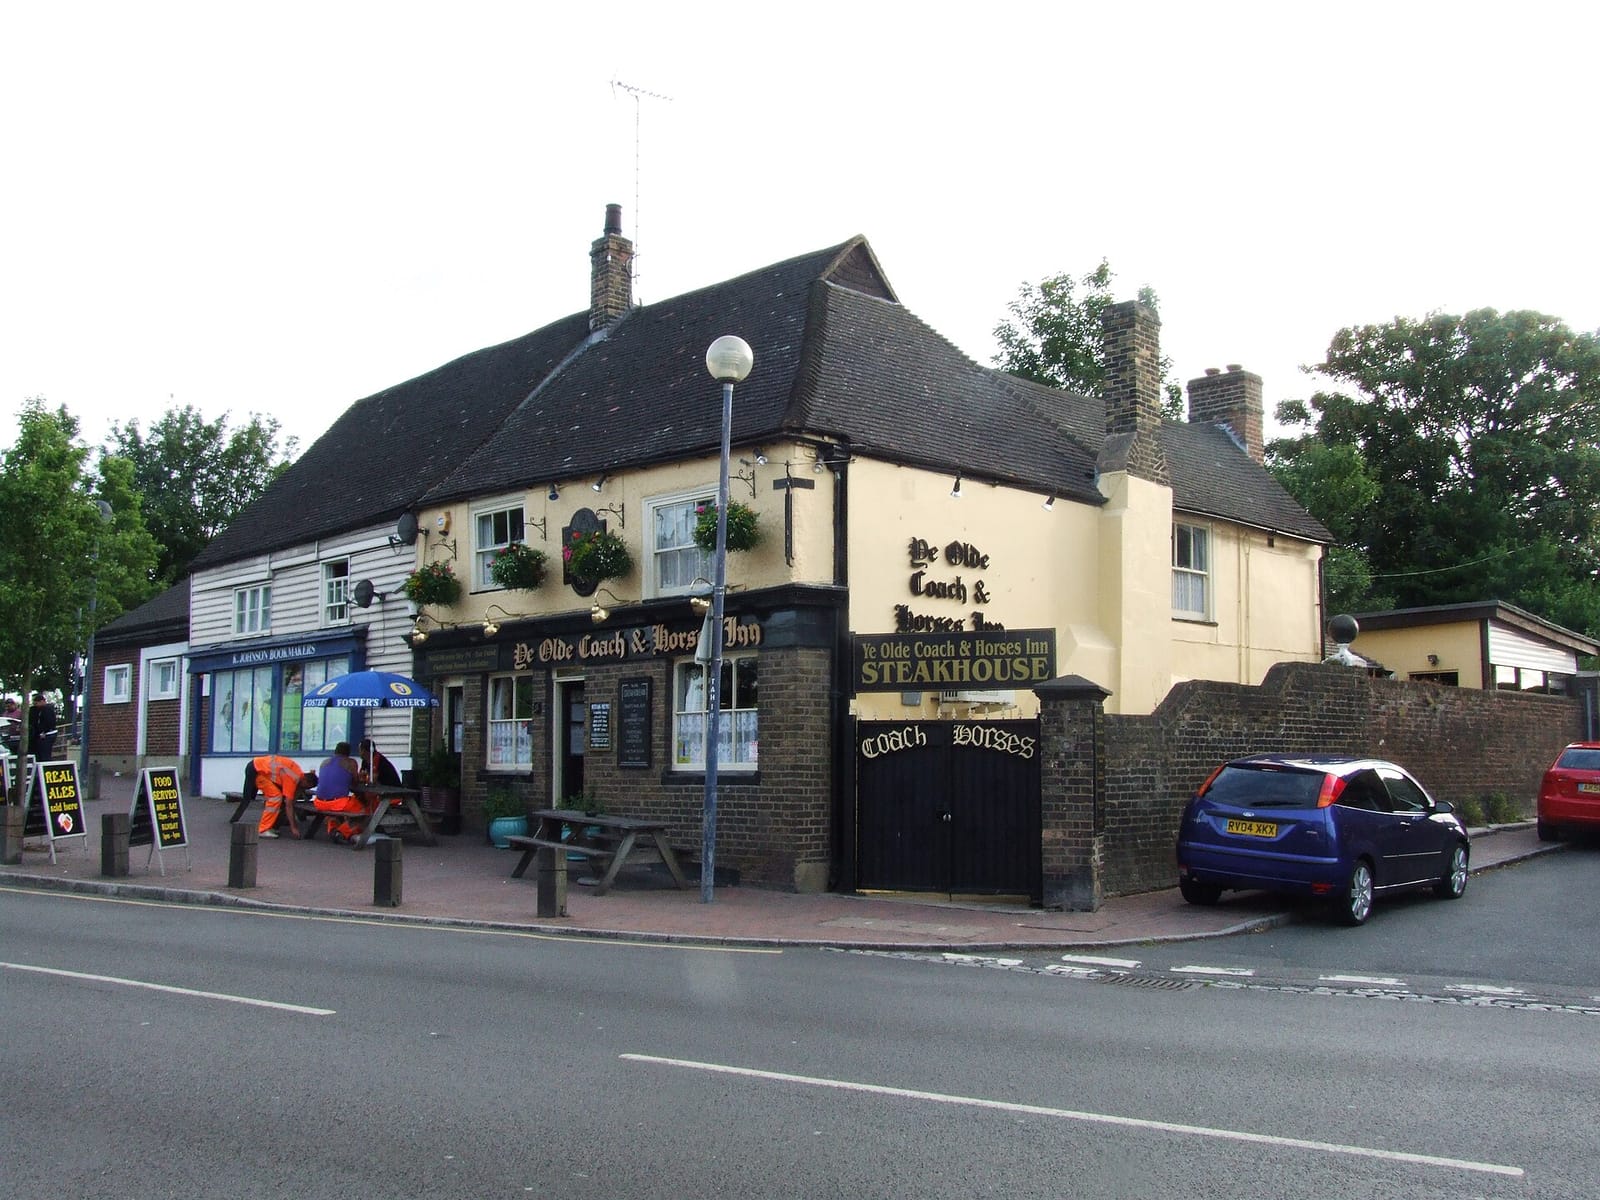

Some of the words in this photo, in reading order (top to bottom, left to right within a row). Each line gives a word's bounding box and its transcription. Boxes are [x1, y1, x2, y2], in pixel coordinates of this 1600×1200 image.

[908, 537, 939, 568] Ye
[945, 540, 990, 570] Olde
[910, 570, 967, 604] Coach
[974, 580, 990, 604] &
[514, 643, 533, 669] Ye
[539, 638, 573, 662] Olde
[578, 633, 626, 658] Coach
[631, 629, 646, 653] &
[652, 624, 700, 655] Hors
[724, 616, 761, 648] Inn
[863, 643, 877, 659] Ye
[881, 641, 910, 658] Olde
[914, 640, 955, 658] Coach
[959, 639, 972, 656] &
[975, 638, 1022, 656] Horses
[1026, 637, 1049, 655] Inn
[240, 649, 268, 663] JOHNSON
[269, 643, 316, 660] BOOKMAKERS
[861, 657, 1050, 684] STEAKHOUSE
[337, 698, 380, 707] FOSTER'S
[390, 698, 426, 707] FOSTER'S
[861, 725, 928, 759] Coach
[952, 724, 1036, 759] Horses
[45, 770, 74, 784] REAL
[153, 776, 172, 787] FOOD
[48, 785, 76, 799] ALES
[152, 789, 178, 801] SERVED
[1227, 820, 1253, 833] RV04
[1255, 825, 1275, 835] XKX
